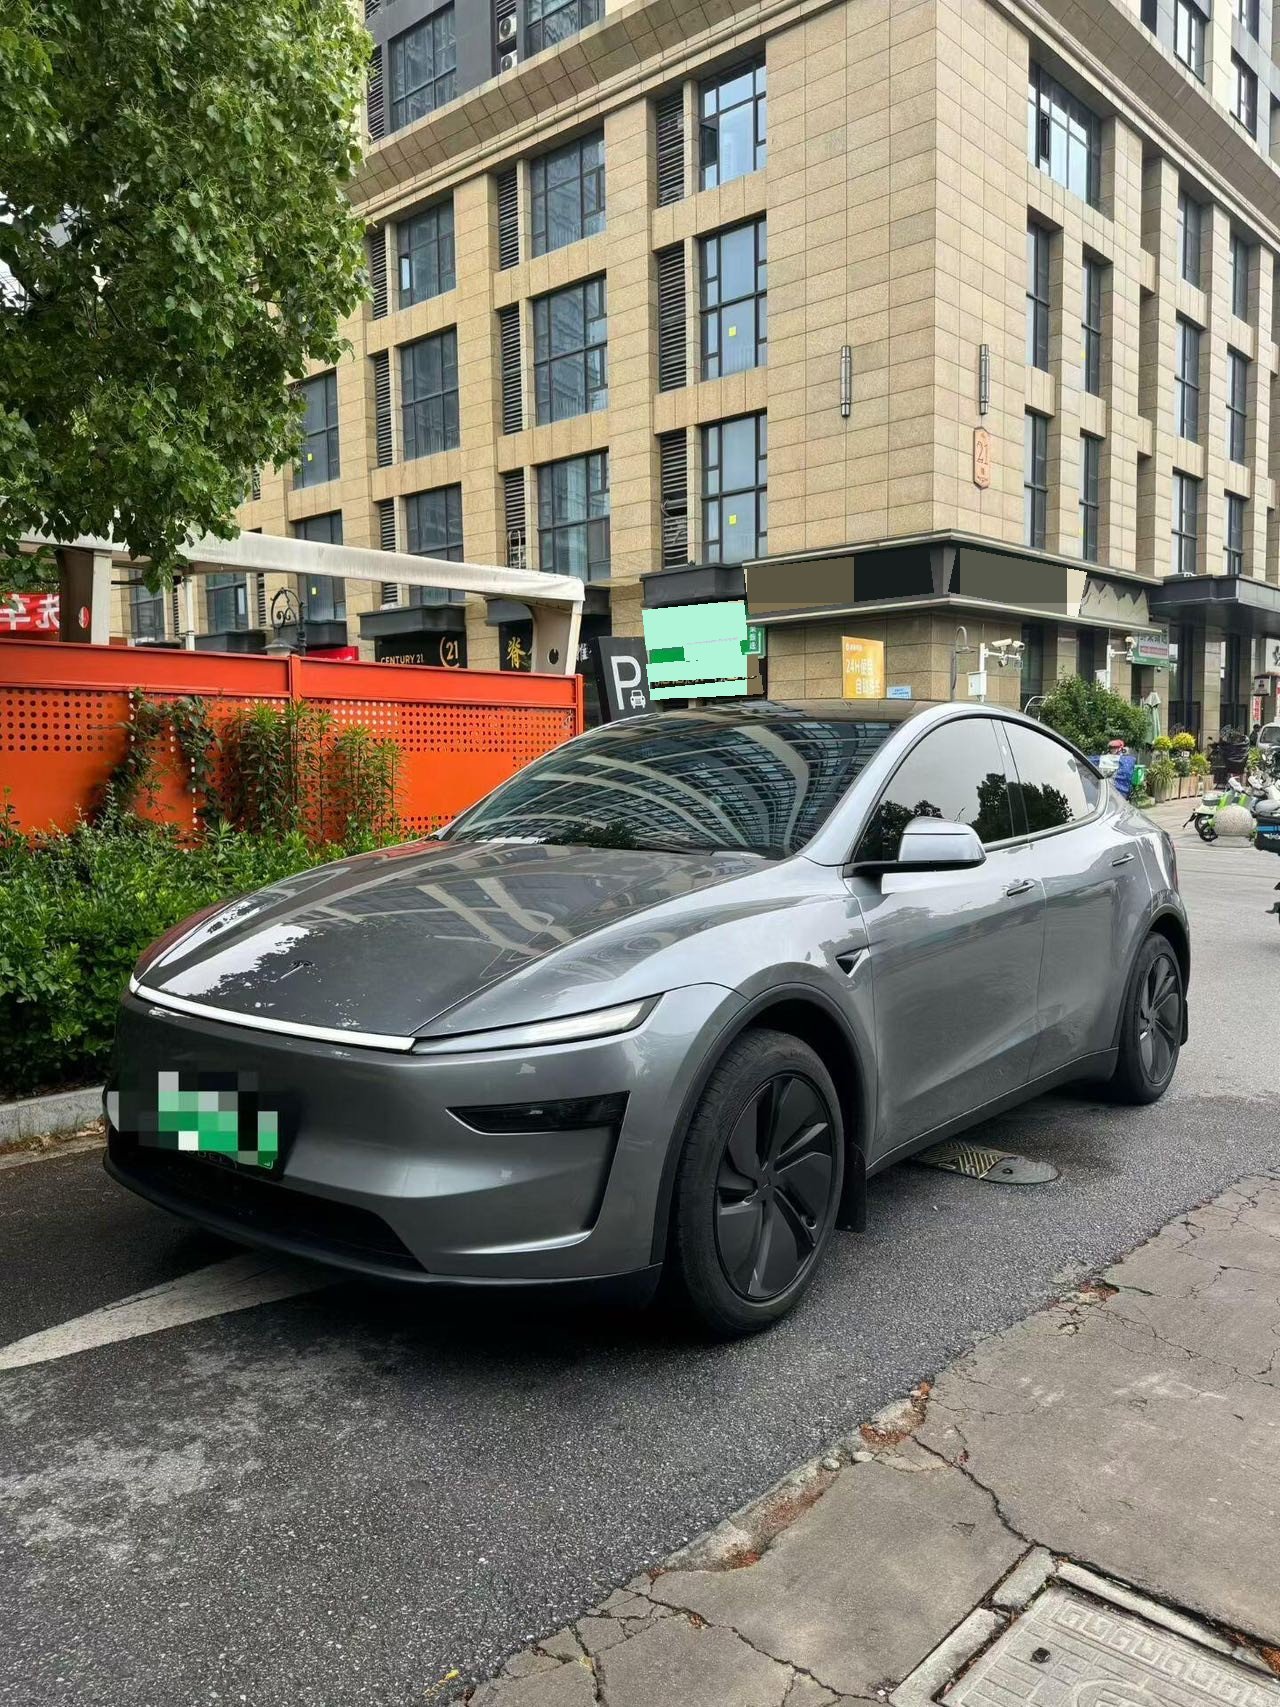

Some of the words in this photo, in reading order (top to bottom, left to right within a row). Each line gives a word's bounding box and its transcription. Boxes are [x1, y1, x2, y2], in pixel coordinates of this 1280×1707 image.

[380, 656, 415, 665] CENTURY
[416, 653, 425, 664] 21
[611, 655, 642, 710] P
